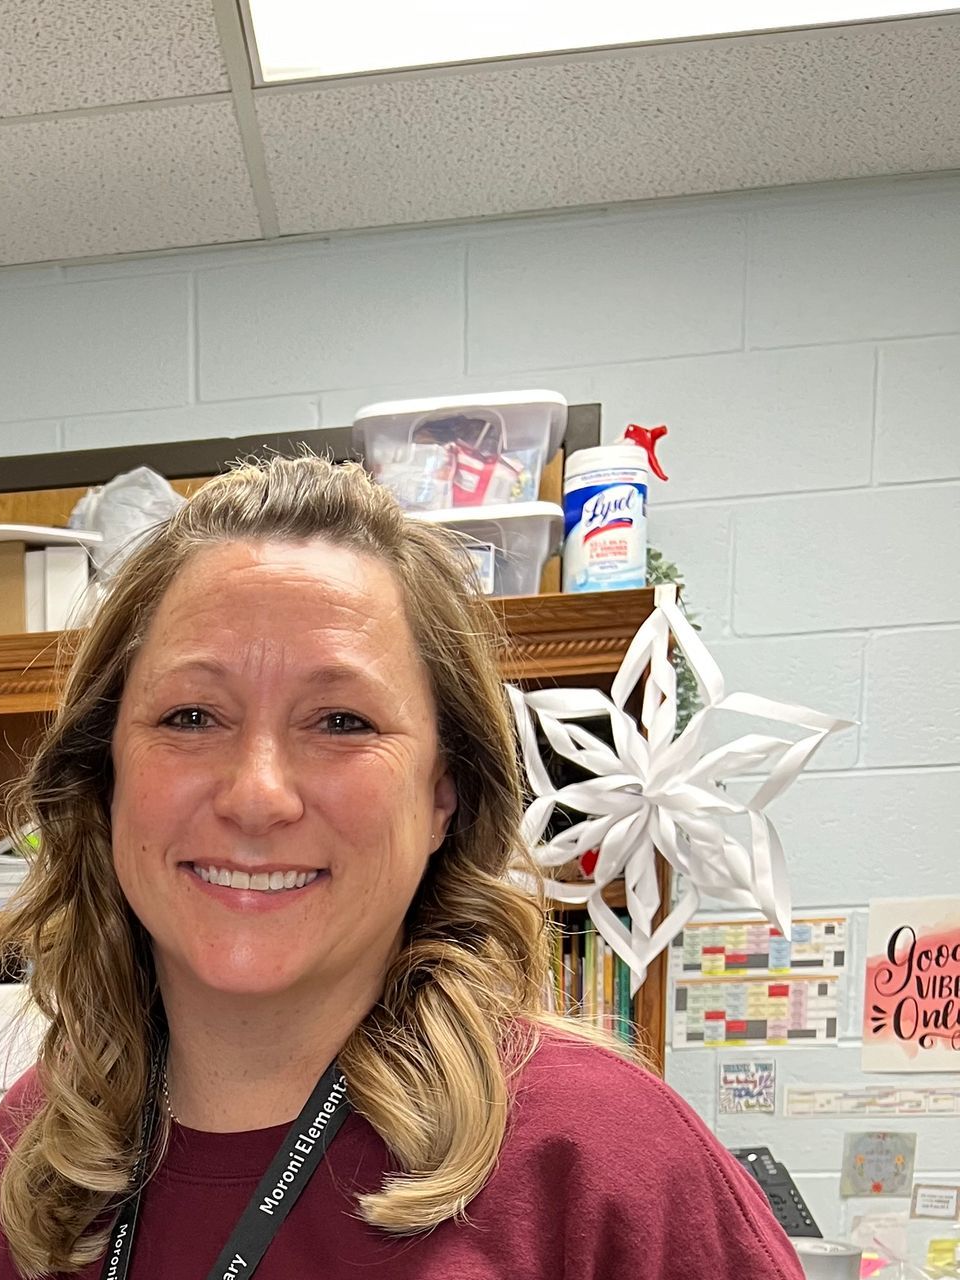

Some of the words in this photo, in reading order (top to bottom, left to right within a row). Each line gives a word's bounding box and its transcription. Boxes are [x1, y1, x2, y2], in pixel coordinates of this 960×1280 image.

[585, 489, 634, 527] Lysol
[893, 996, 960, 1050] Onl
[259, 1152, 305, 1216] Moroni
